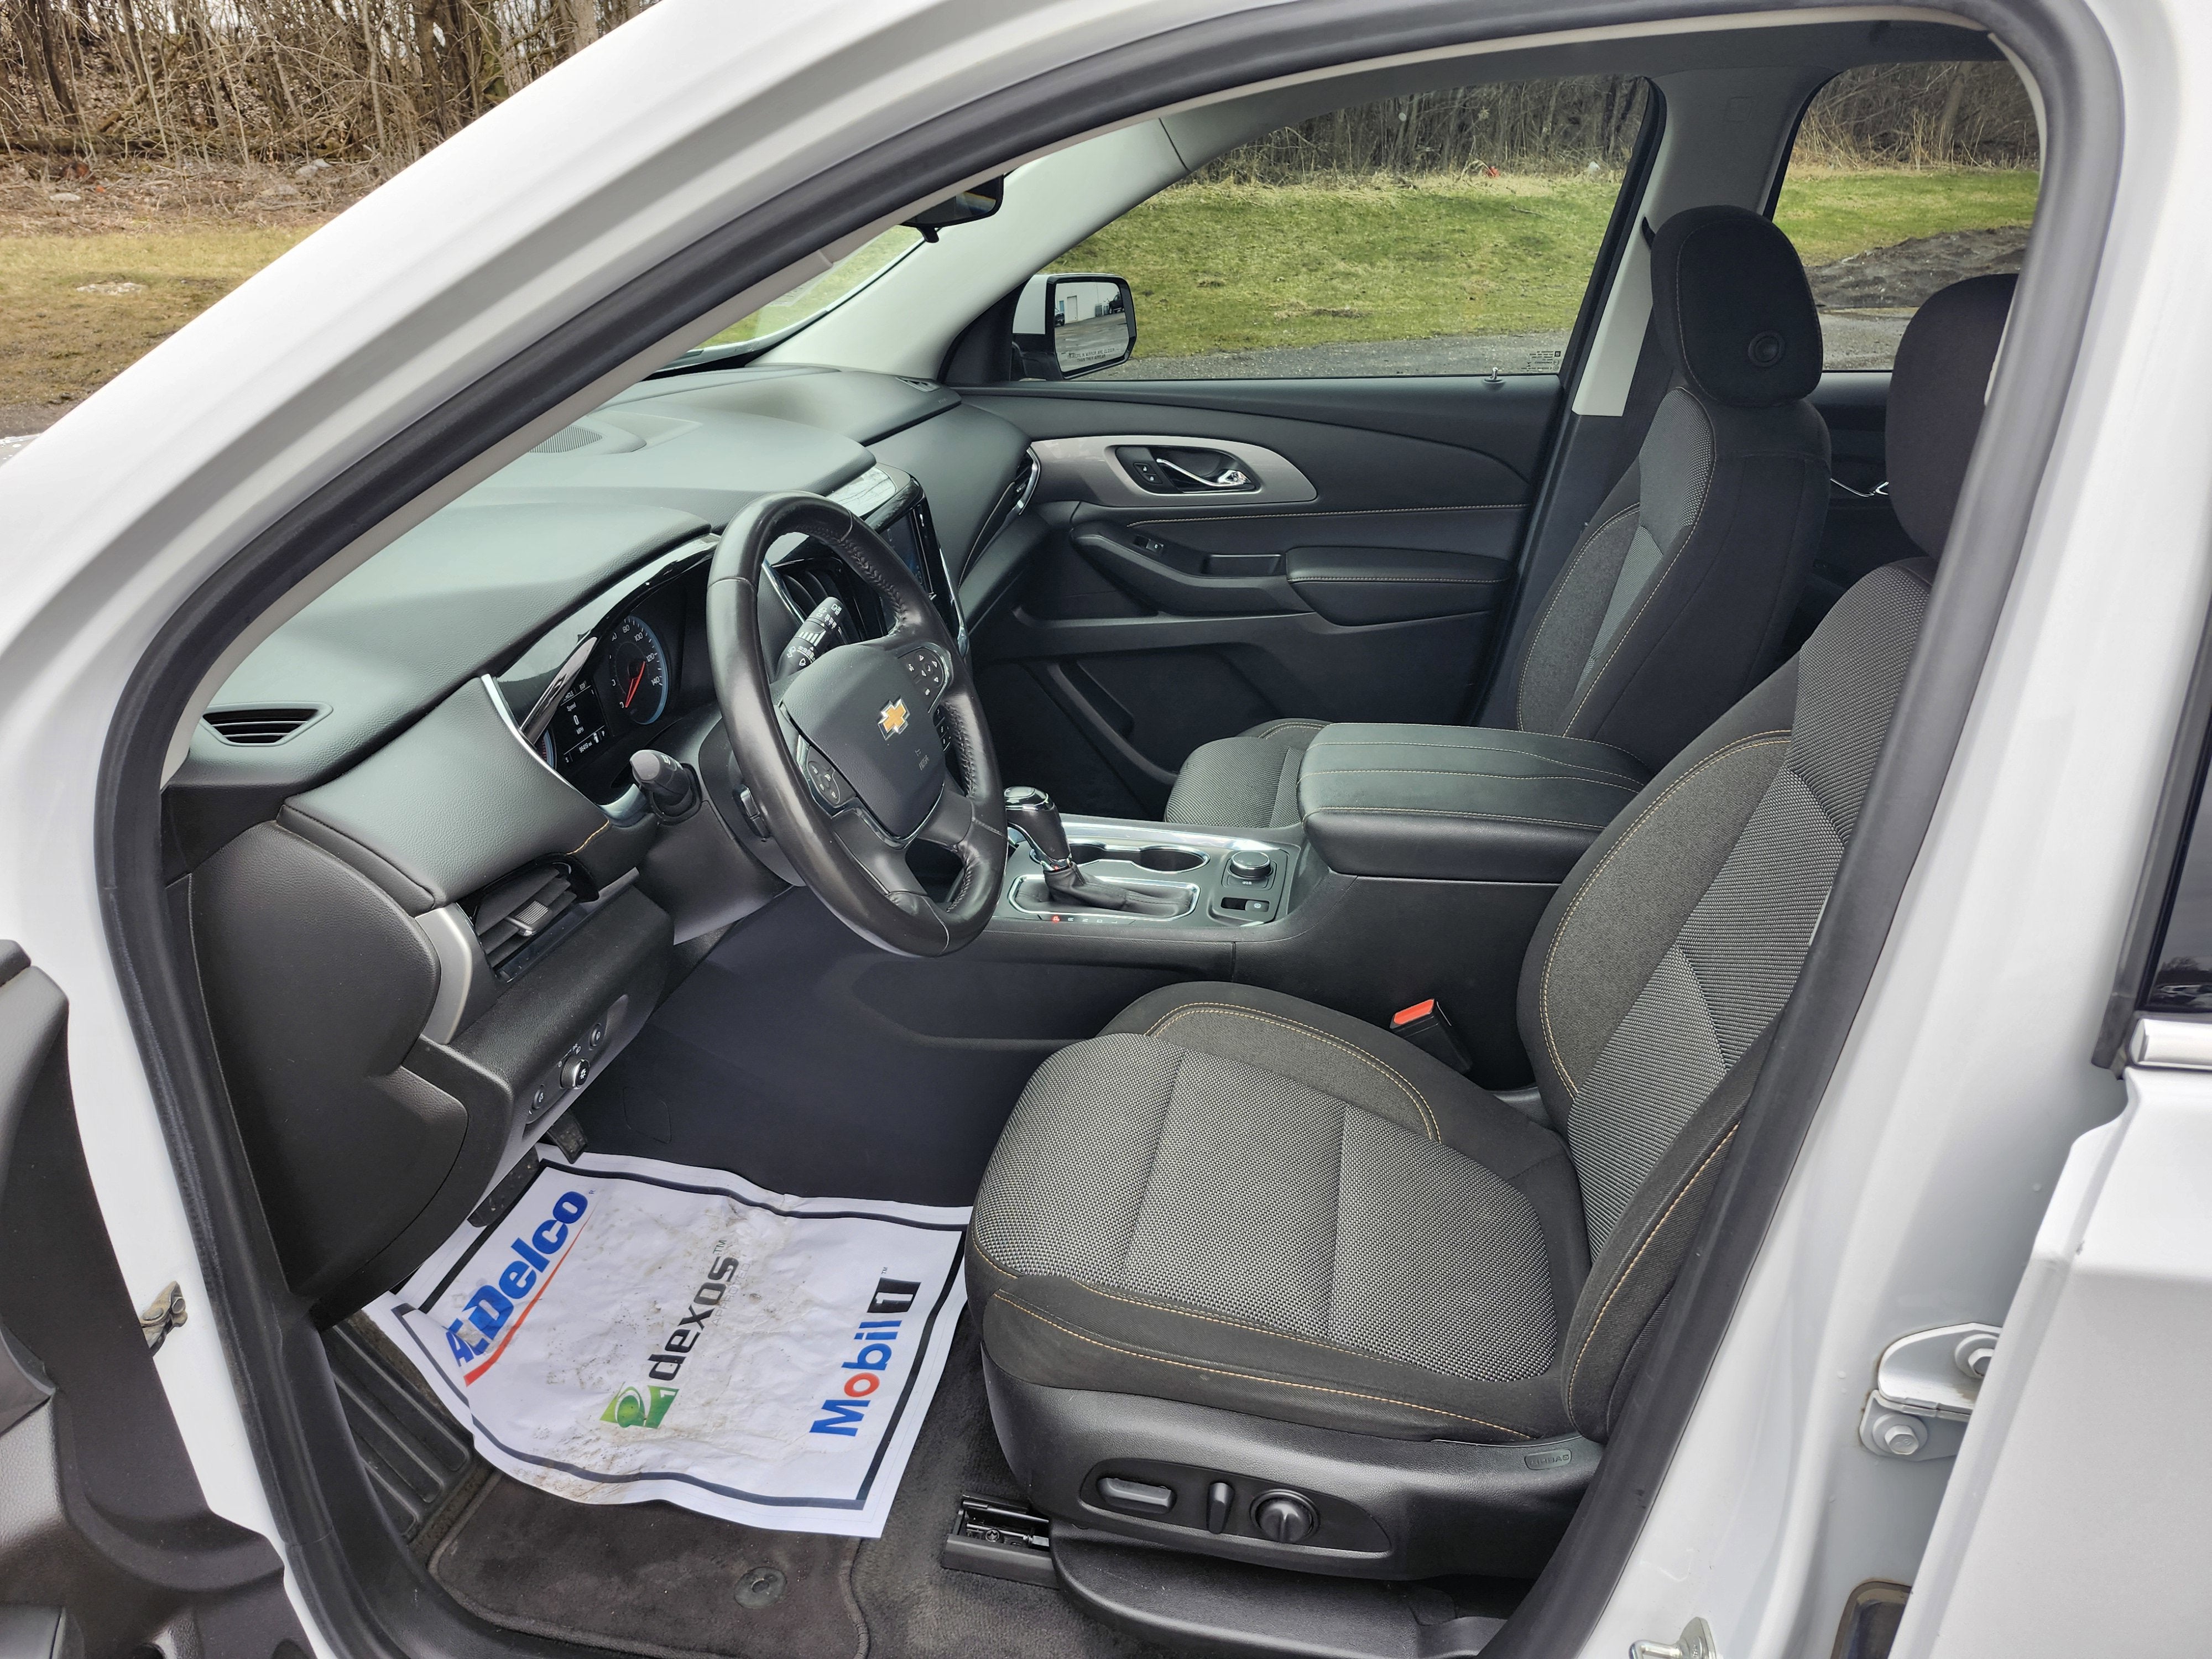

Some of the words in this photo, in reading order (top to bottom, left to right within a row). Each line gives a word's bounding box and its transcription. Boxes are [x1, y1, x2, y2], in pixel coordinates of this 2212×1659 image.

[622, 624, 630, 633] 80
[634, 632, 643, 642] 100
[646, 653, 655, 662] 120
[651, 676, 660, 686] 140
[567, 702, 577, 712] Speed
[573, 714, 580, 726] 0
[576, 726, 585, 735] MPH
[711, 1262, 751, 1327] APPROVED
[647, 1256, 739, 1381] dexos
[809, 1320, 902, 1437] Mobil
